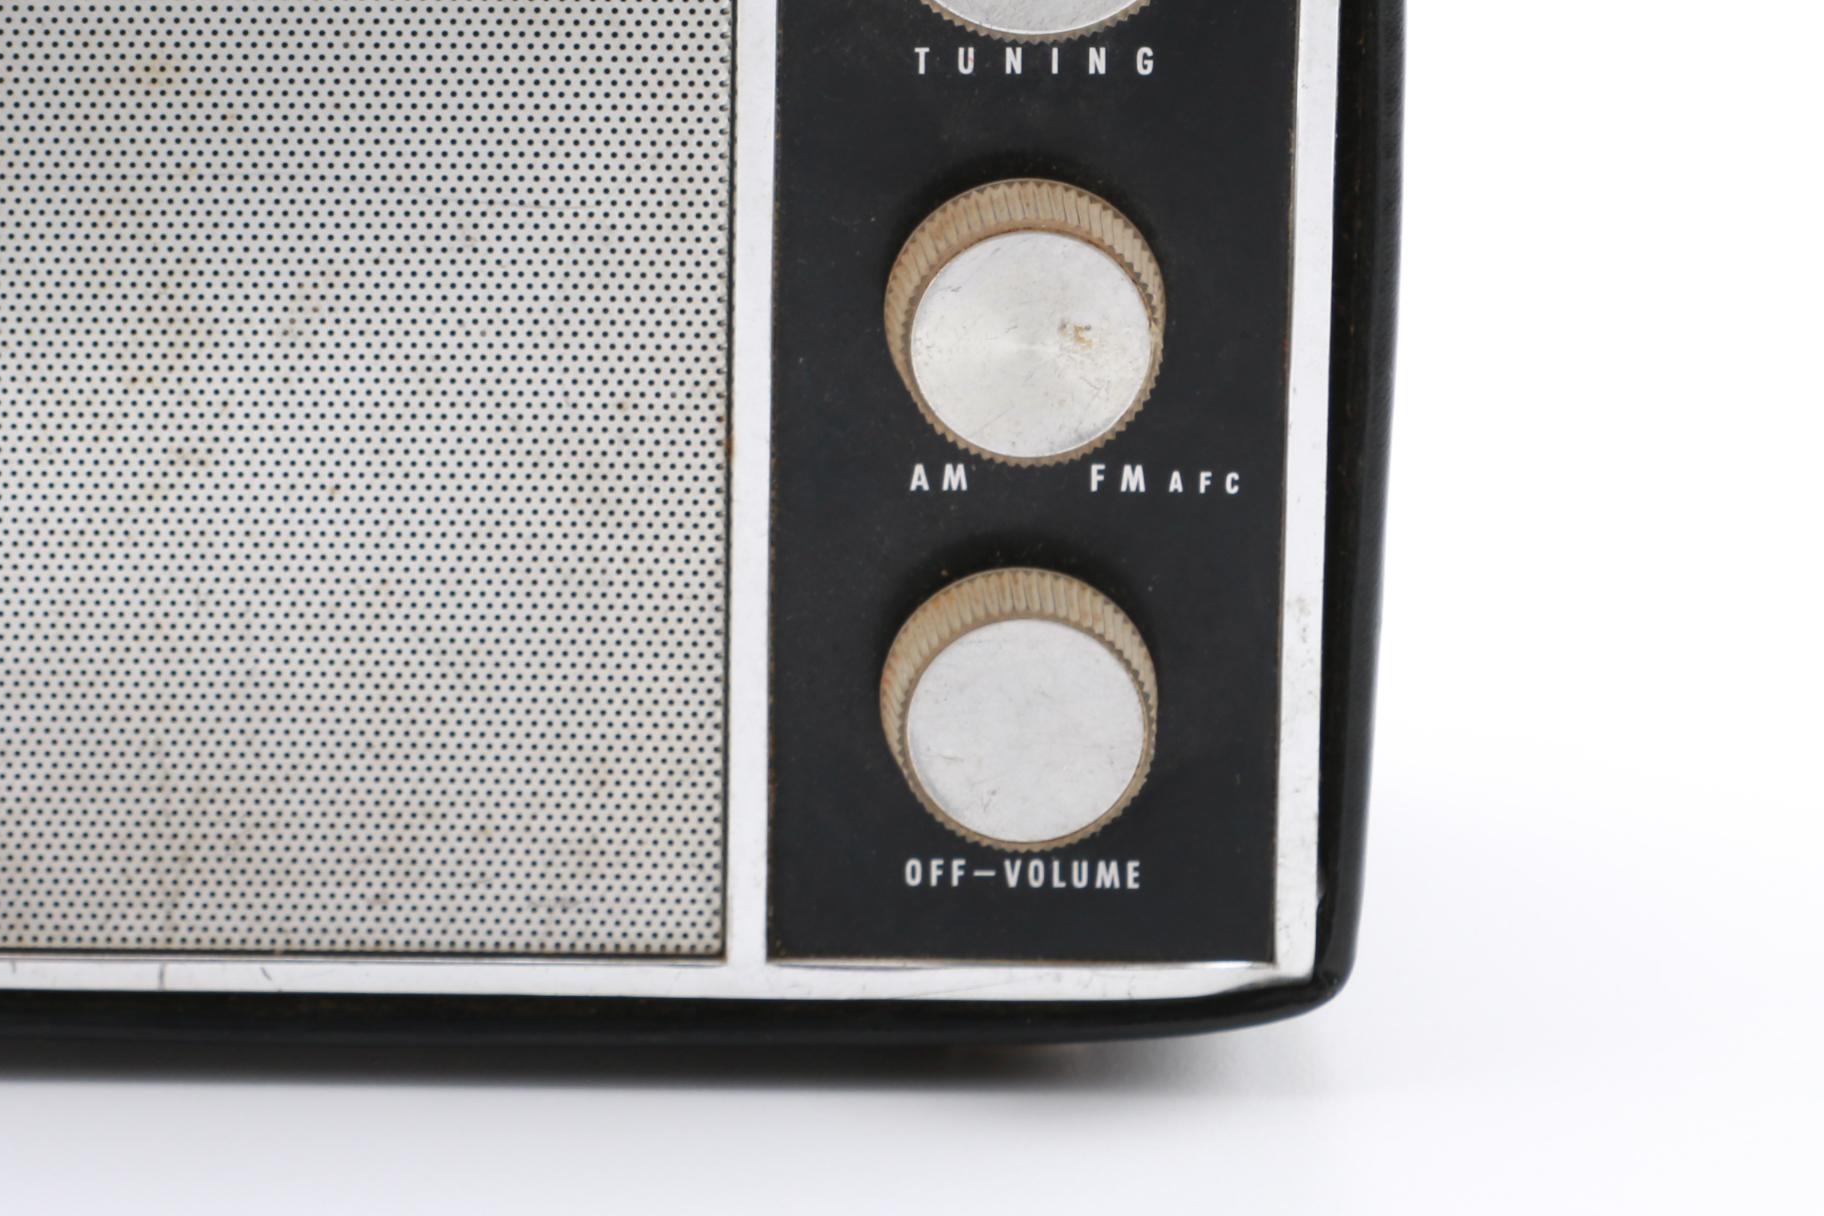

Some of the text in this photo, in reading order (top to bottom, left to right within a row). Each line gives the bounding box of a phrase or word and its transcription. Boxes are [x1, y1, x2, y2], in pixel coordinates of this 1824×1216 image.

[915, 47, 1153, 75] TUNING
[910, 464, 967, 491] AM
[1091, 464, 1145, 492] FM
[1169, 471, 1239, 494] AFC
